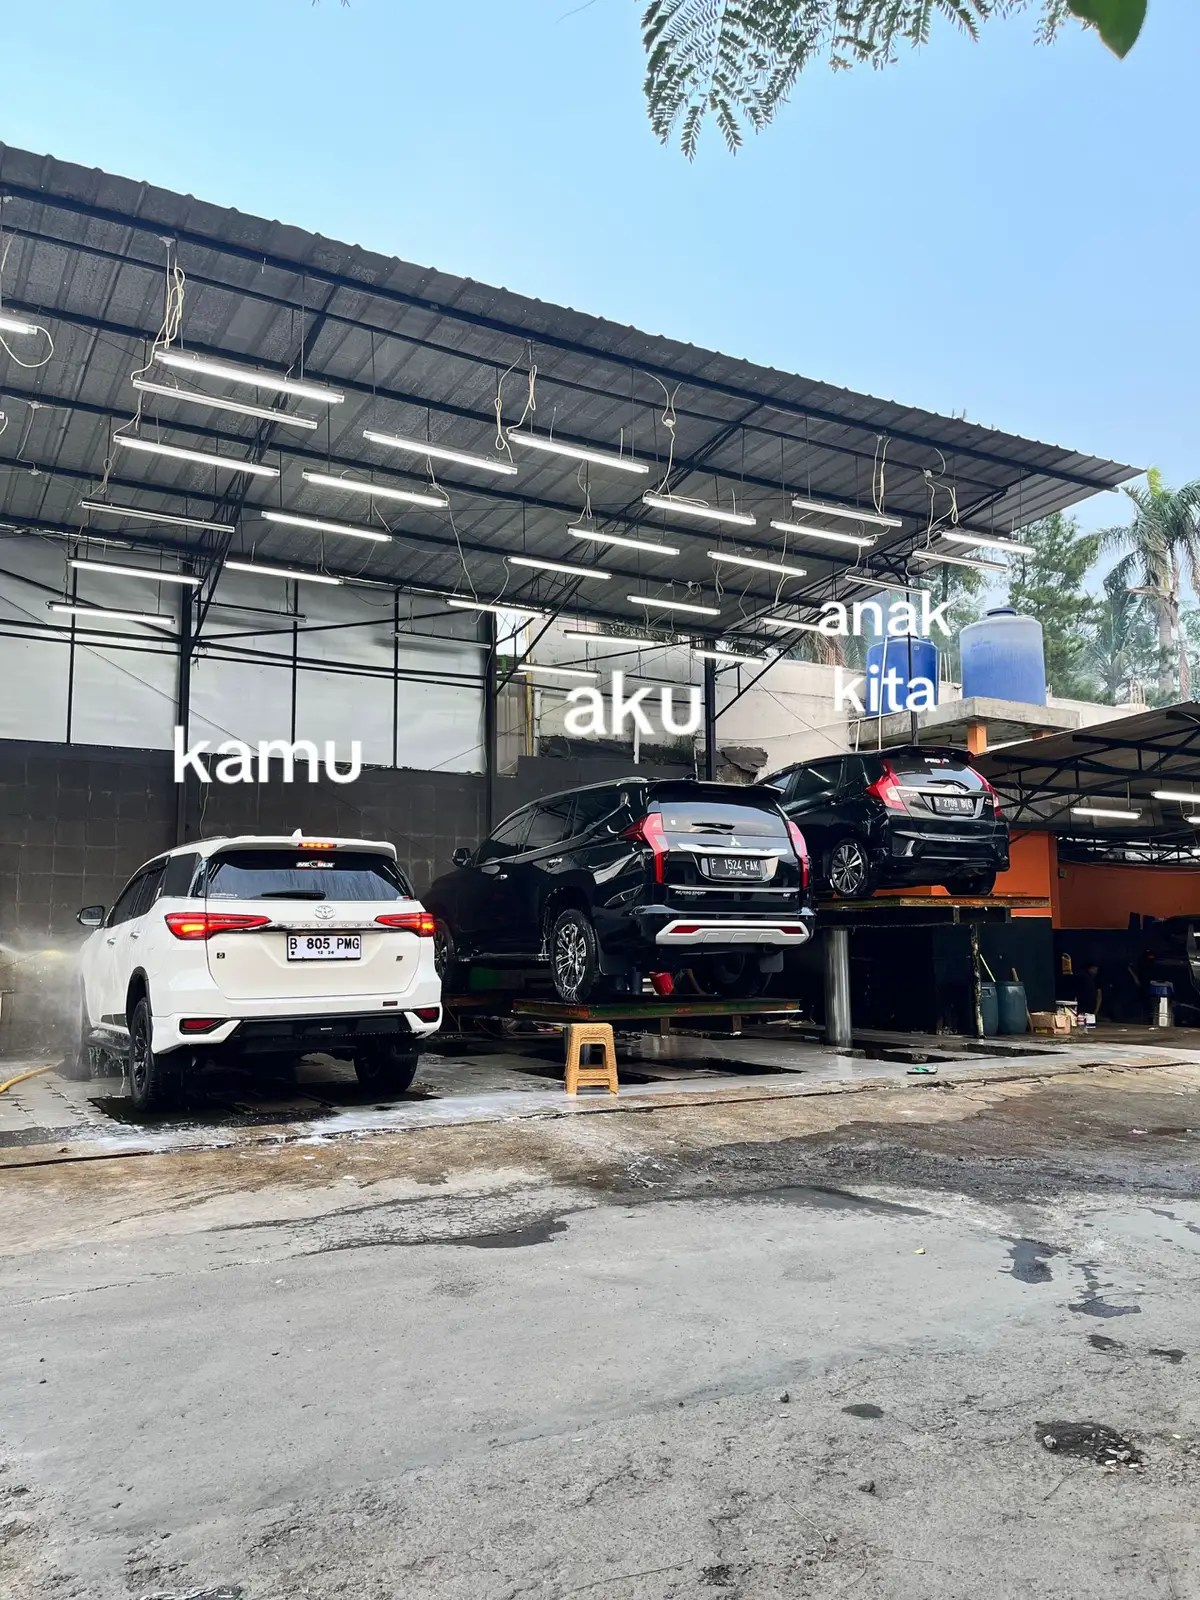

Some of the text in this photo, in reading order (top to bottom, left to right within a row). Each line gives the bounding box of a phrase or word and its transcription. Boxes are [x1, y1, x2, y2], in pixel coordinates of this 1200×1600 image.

[711, 858, 760, 871] F 1524 FAK
[289, 937, 360, 950] B 805 PMG
